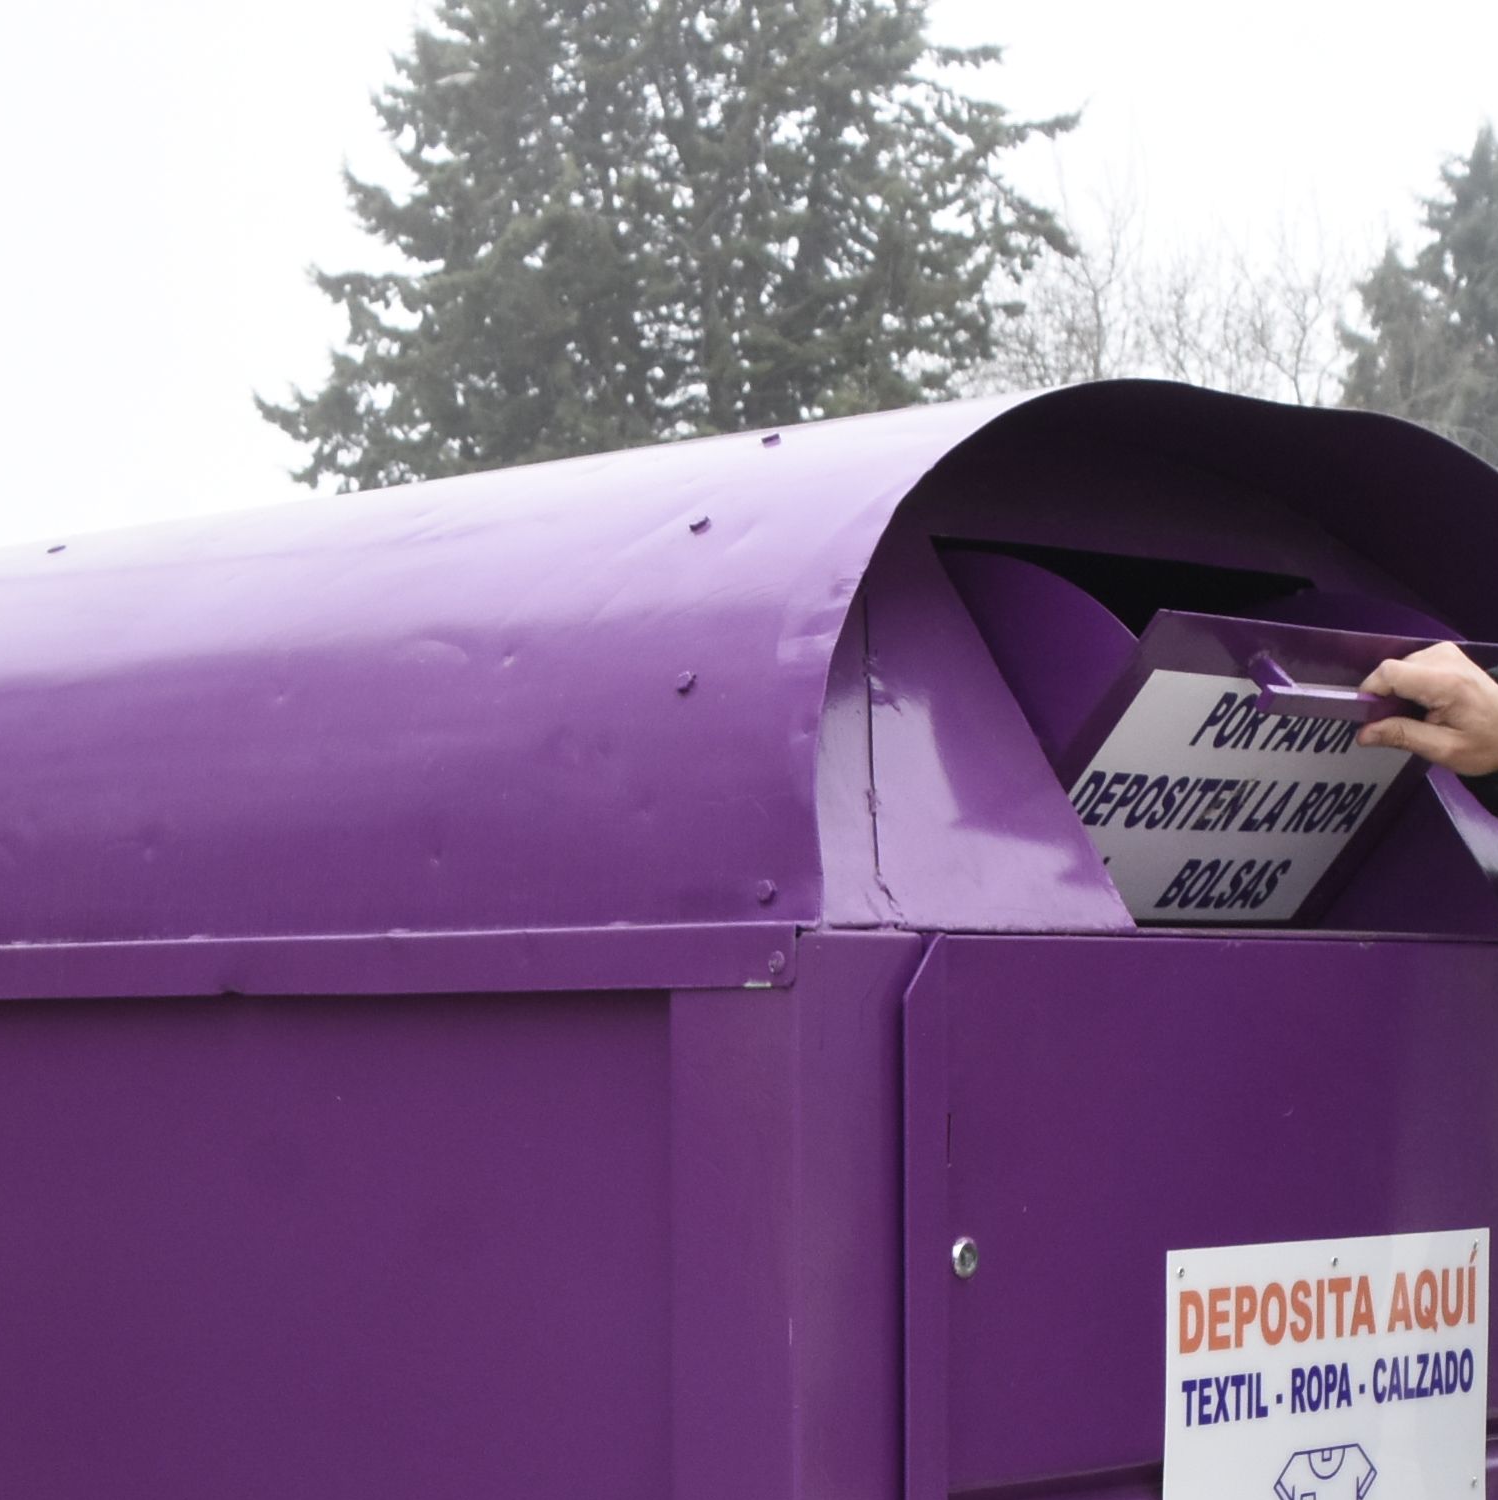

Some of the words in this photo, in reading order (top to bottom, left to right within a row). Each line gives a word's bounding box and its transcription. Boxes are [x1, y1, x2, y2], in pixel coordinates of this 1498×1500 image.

[1188, 691, 1270, 749] POR
[1072, 770, 1261, 831] DEPOSITEN
[1237, 779, 1300, 833] LA
[1280, 781, 1379, 835] ROPA
[1154, 858, 1291, 909] BOLSAS
[1178, 1273, 1376, 1355] DEPOSITA
[1387, 1248, 1478, 1333] AQUÍ
[1181, 1371, 1269, 1428] TEXTIL
[1290, 1361, 1352, 1414] ROPA
[1372, 1347, 1474, 1405] CALZADO
